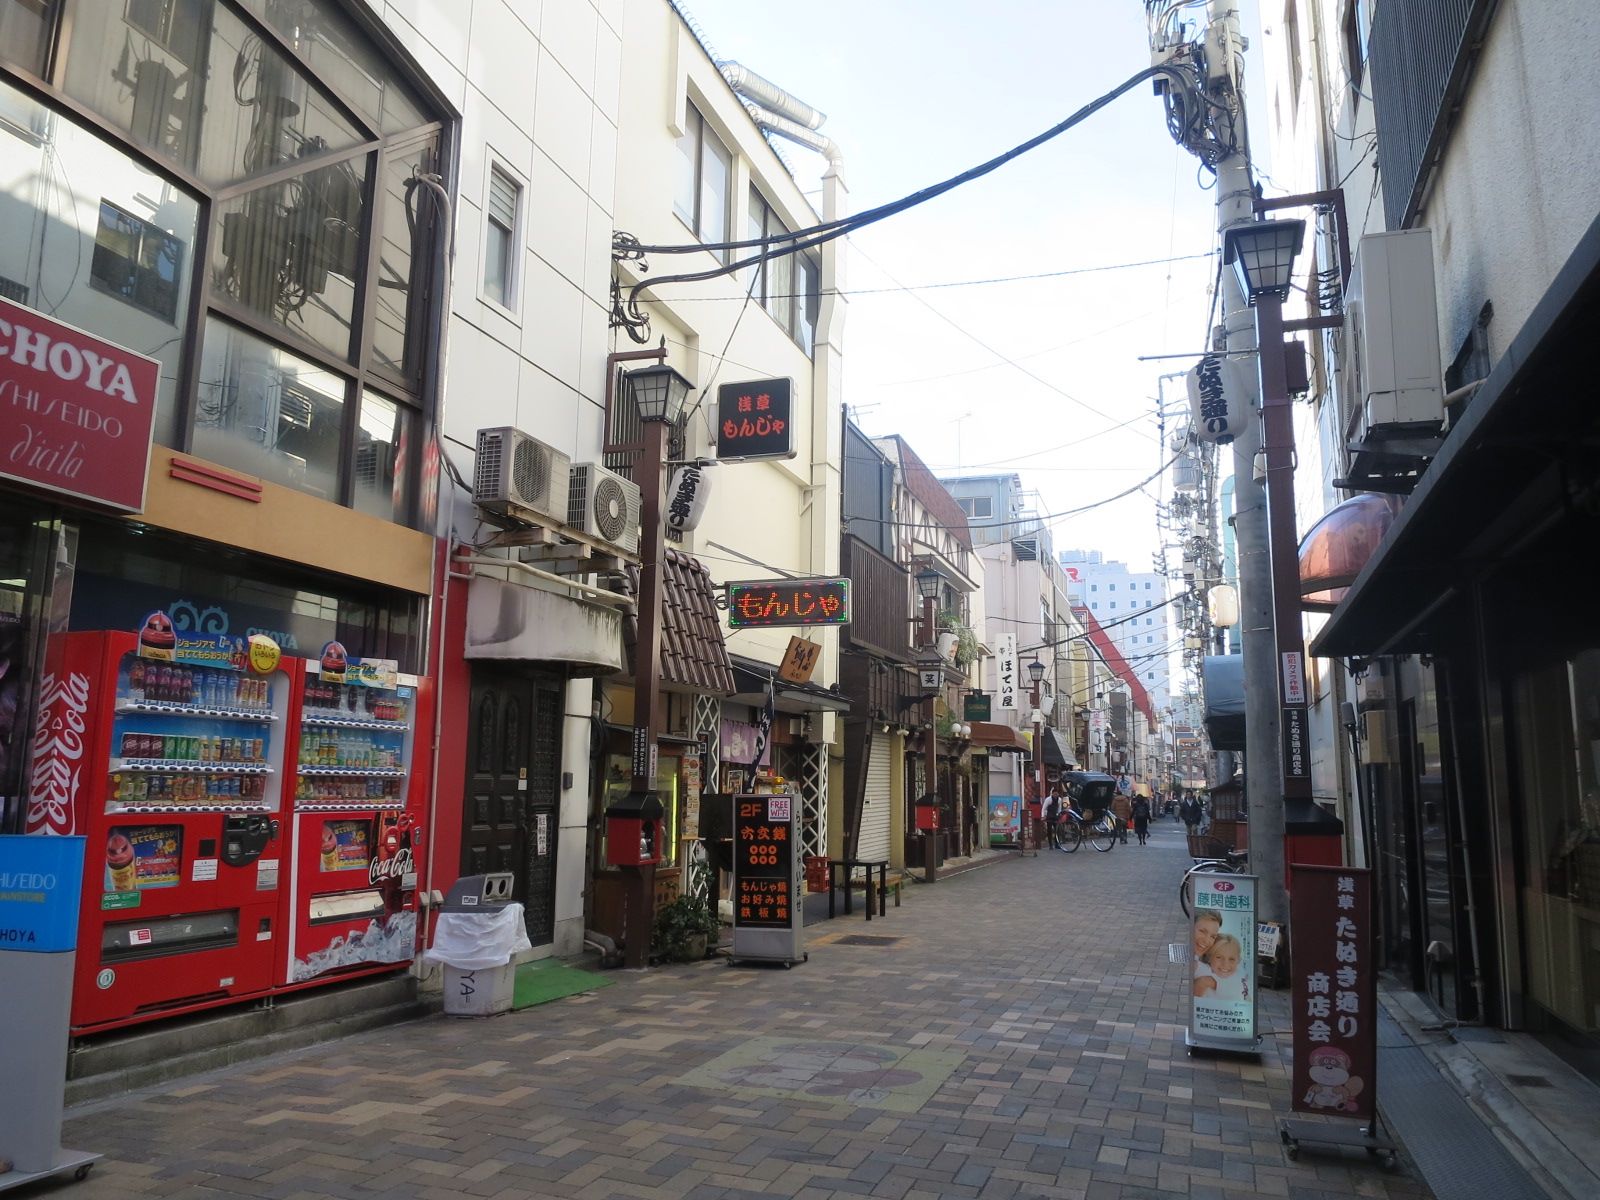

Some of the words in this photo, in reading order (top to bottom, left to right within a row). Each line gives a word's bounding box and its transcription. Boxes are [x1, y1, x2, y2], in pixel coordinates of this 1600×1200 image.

[738, 394, 772, 413] 浅草
[1196, 354, 1228, 433] たぬき通り
[723, 414, 785, 438] もんじゃ
[669, 467, 702, 527] たぬき通り
[738, 592, 839, 618] もんじゃ
[1001, 660, 1013, 707] ほてい屋
[740, 804, 762, 816] 2F
[770, 801, 788, 809] FREE
[1218, 883, 1230, 891] 2F
[1337, 876, 1355, 910] 浅草
[1197, 892, 1250, 909] 藤関歯科
[1335, 916, 1359, 1038] たぬき通り
[1307, 972, 1331, 1042] 商店会
